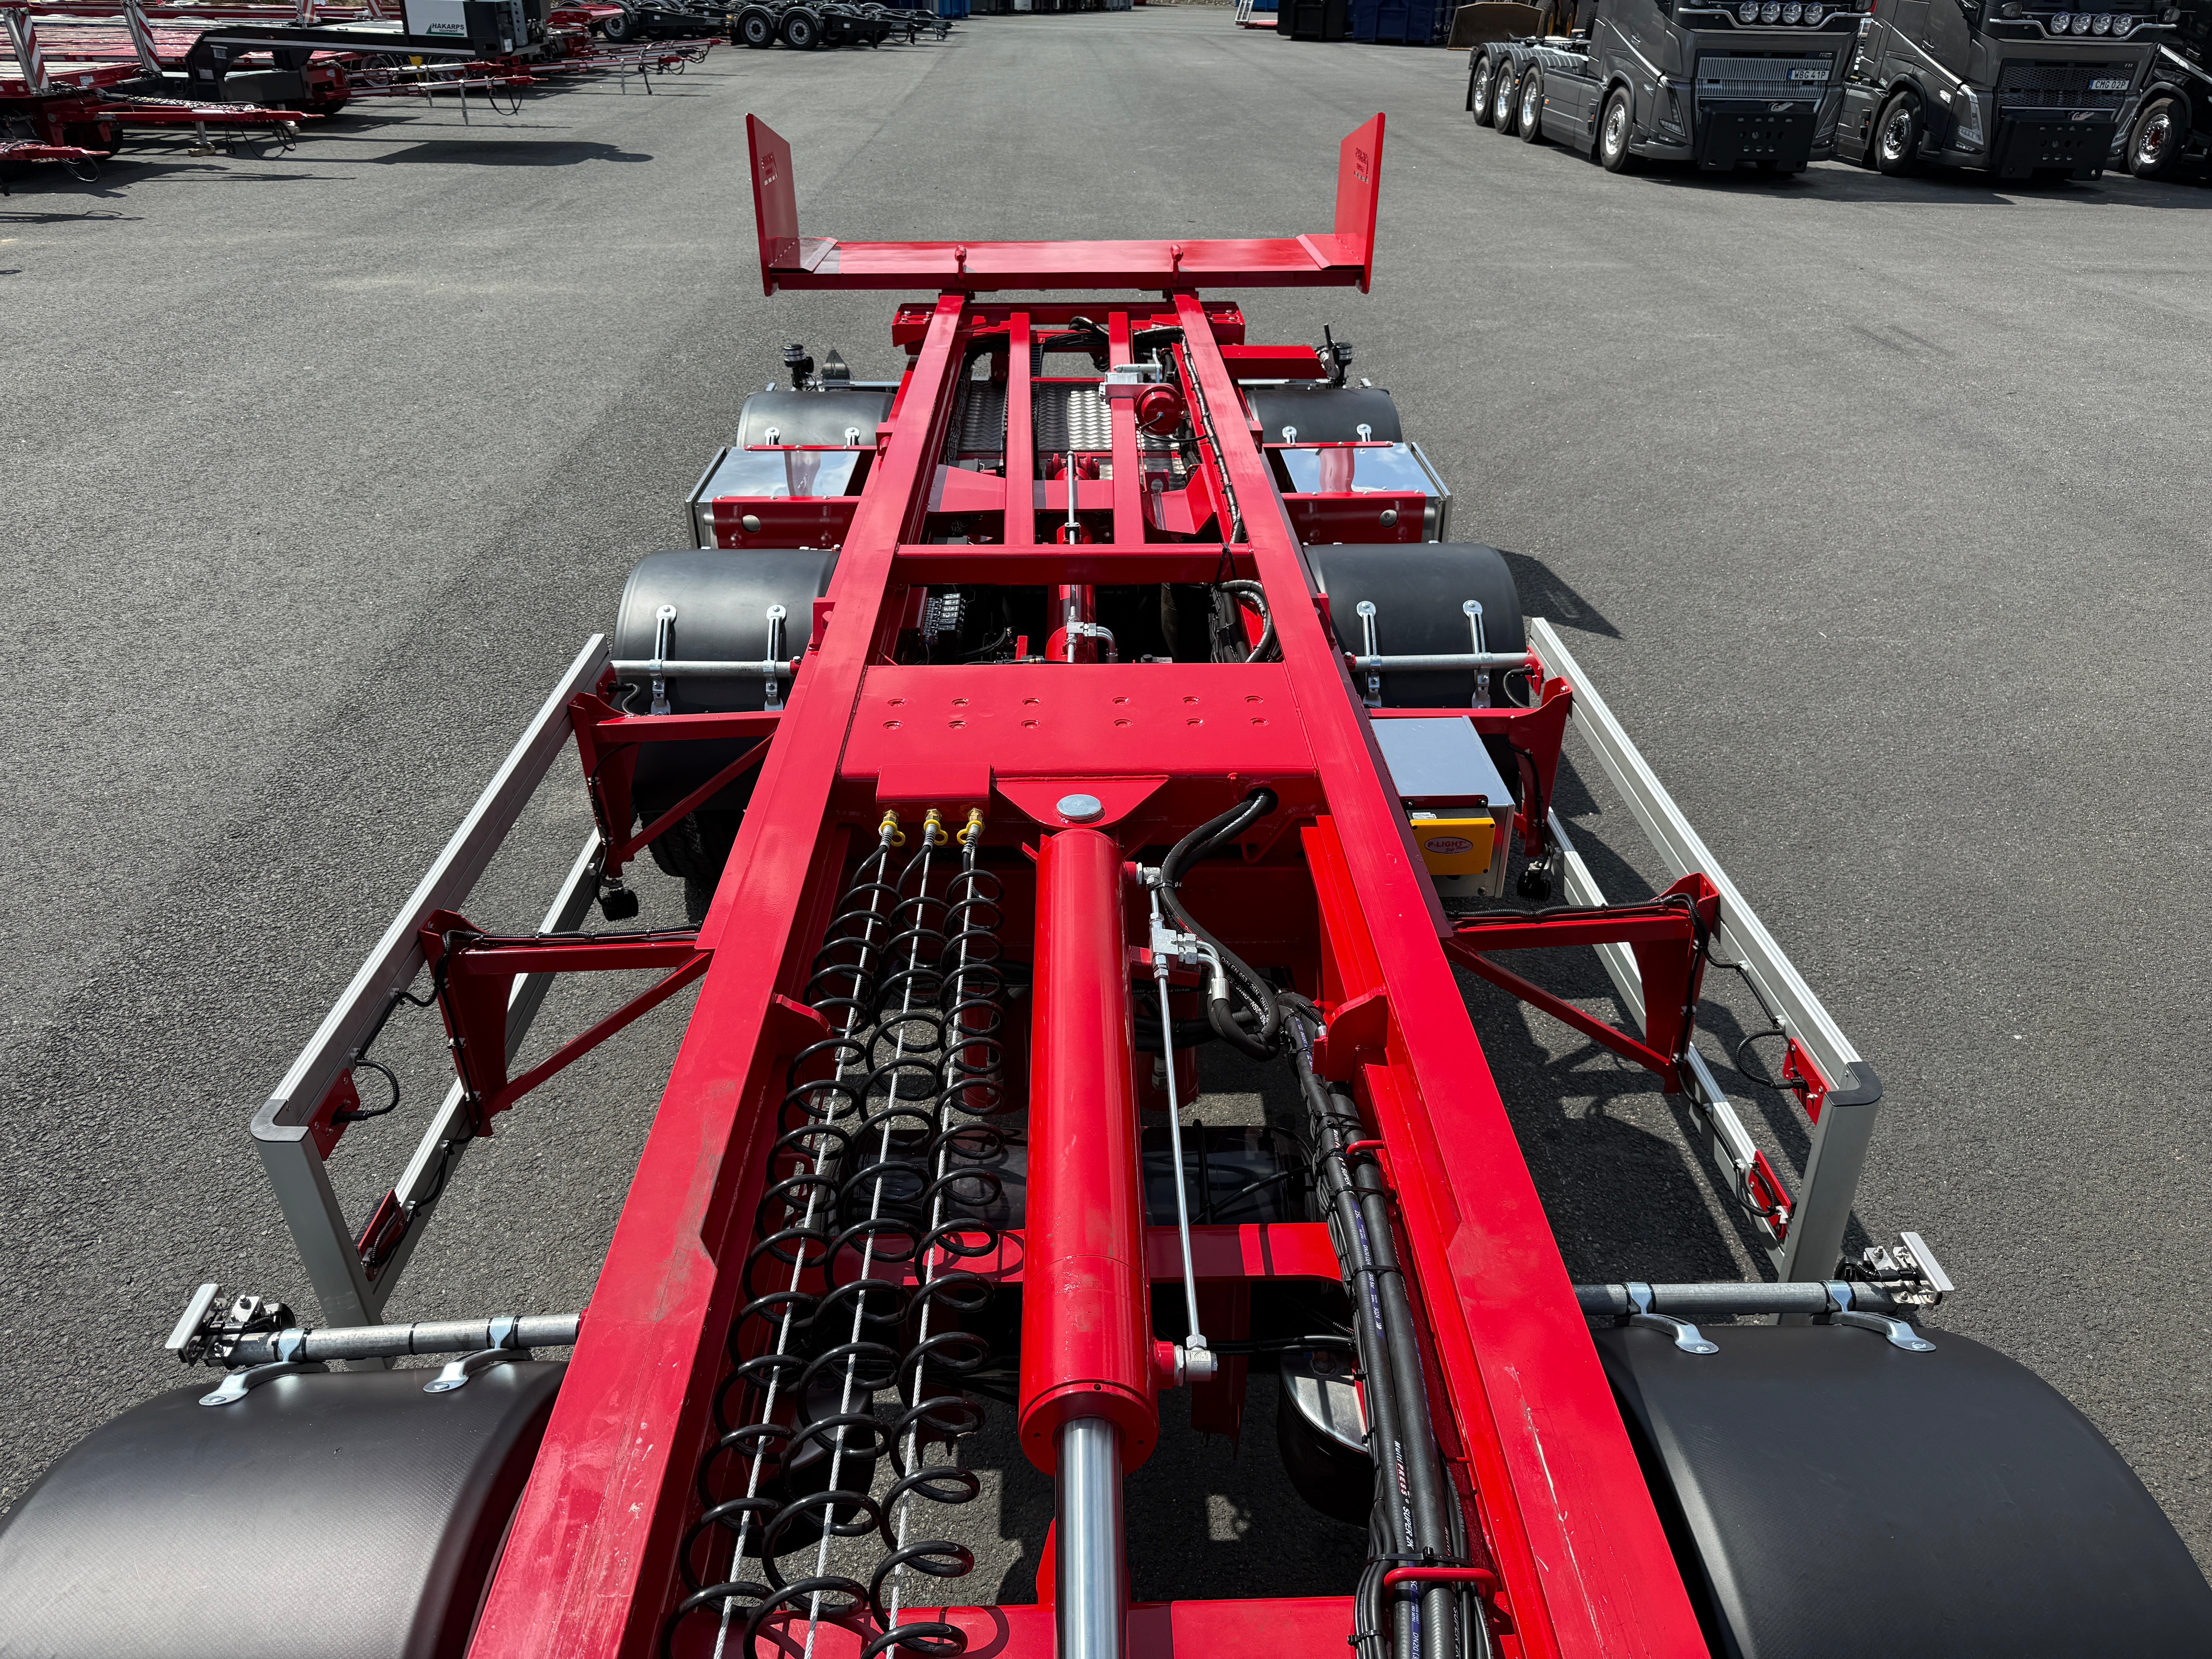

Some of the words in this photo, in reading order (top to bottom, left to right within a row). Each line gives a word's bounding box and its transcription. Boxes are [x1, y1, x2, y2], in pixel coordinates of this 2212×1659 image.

[2095, 81, 2110, 89] CMG
[1221, 957, 1231, 967] DIN
[1231, 965, 1239, 974] EN
[1239, 972, 1248, 983] 853
[1249, 984, 1259, 996] 2SN
[1250, 1001, 1261, 1013] 2SN
[1341, 1167, 1352, 1187] SUPER
[1403, 1506, 1413, 1540] SUPER
[1406, 1537, 1414, 1551] 2K
